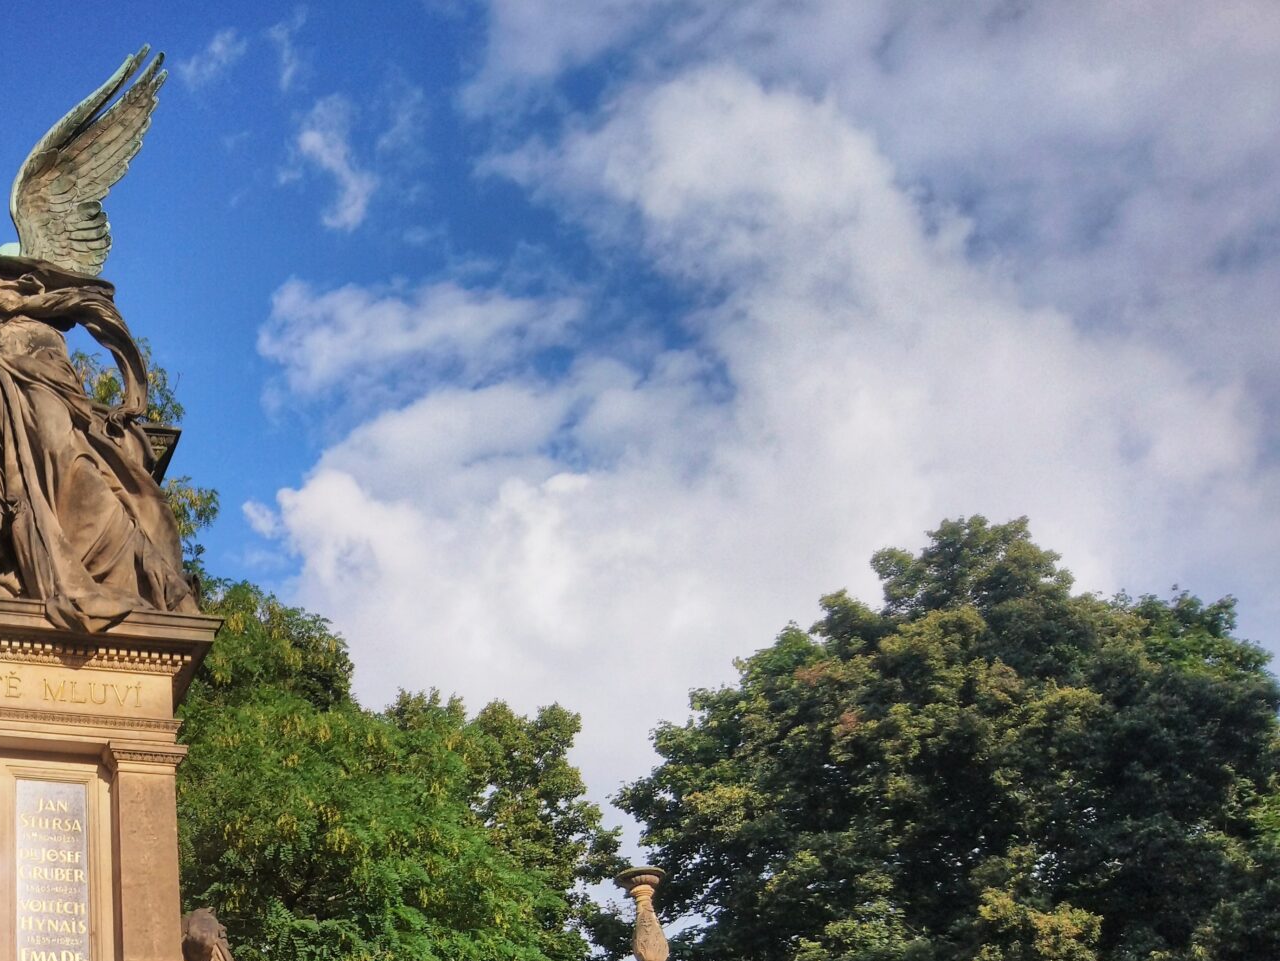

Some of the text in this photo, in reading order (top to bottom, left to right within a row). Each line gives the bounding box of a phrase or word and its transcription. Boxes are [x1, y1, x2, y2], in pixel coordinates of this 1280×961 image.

[43, 678, 144, 708] MLUVÍ
[37, 798, 68, 813] JAN
[39, 848, 82, 864] JOSEF
[19, 865, 87, 883] GRUBER
